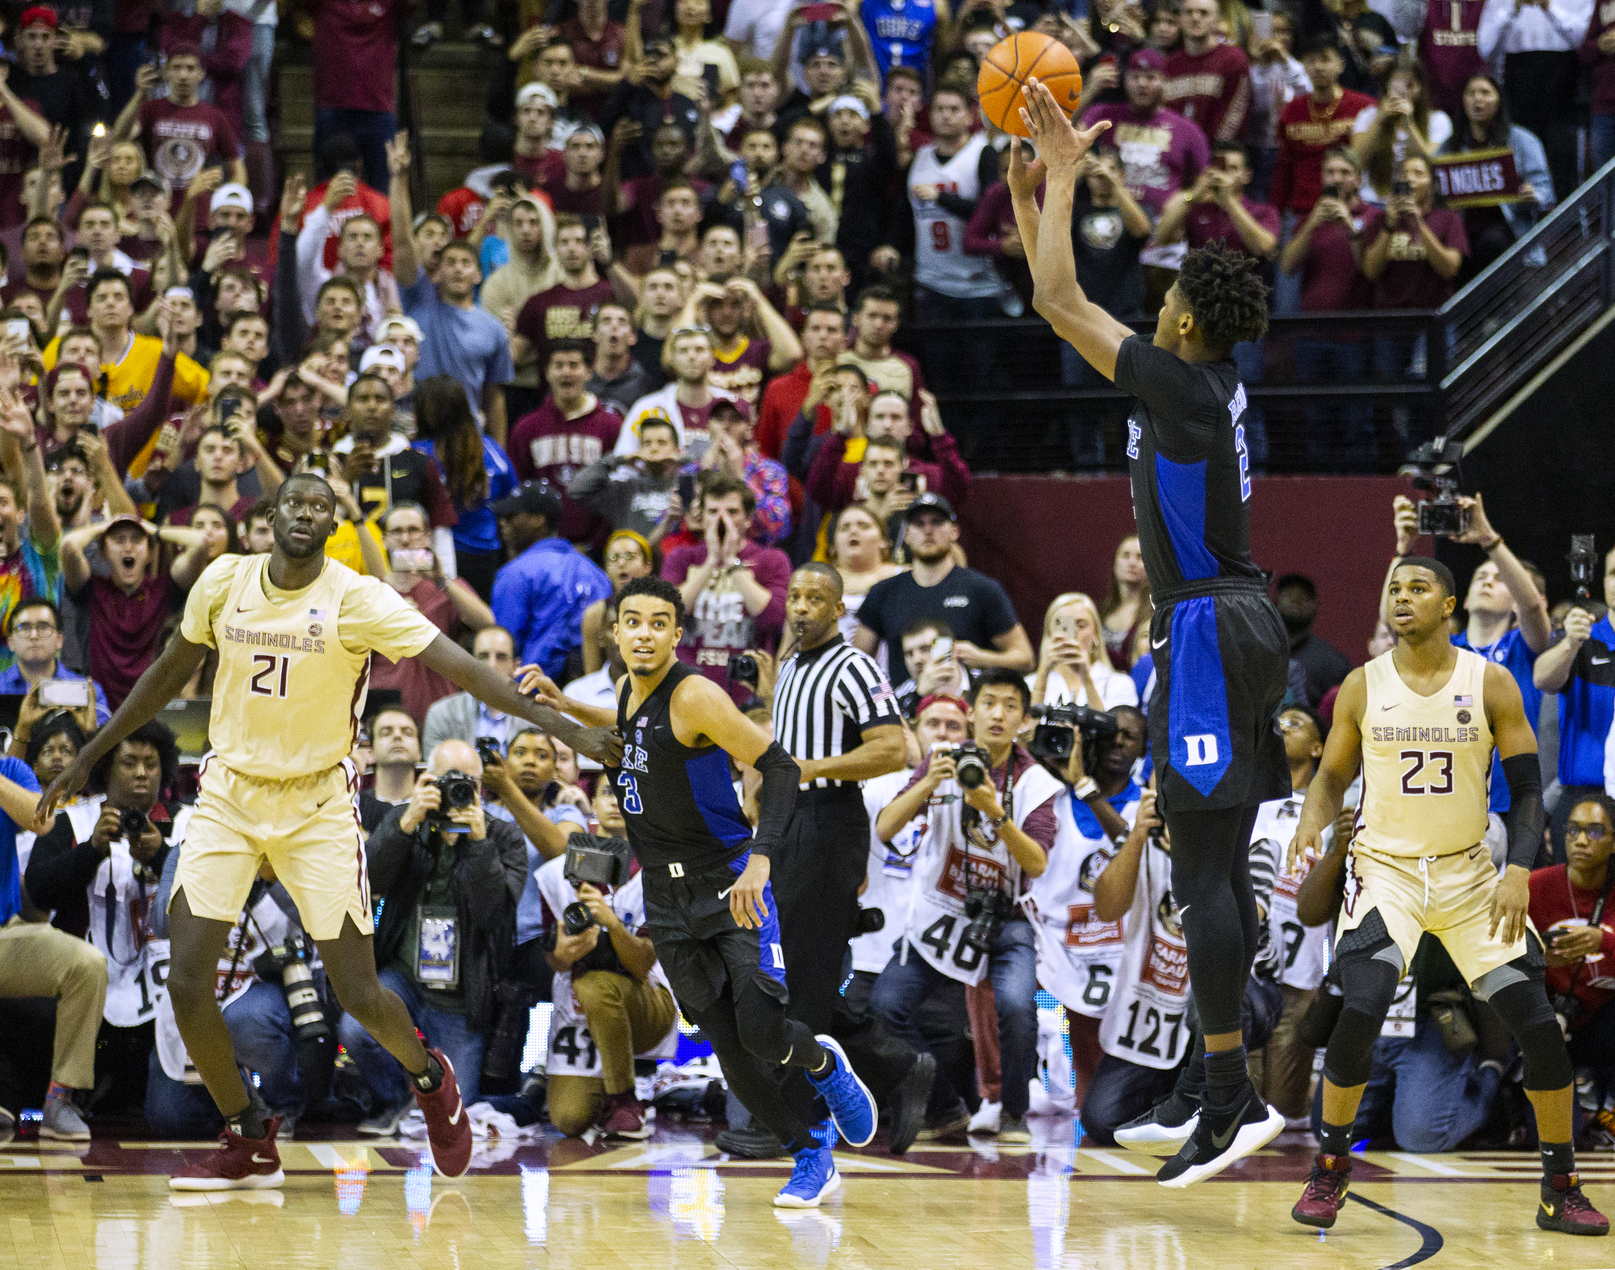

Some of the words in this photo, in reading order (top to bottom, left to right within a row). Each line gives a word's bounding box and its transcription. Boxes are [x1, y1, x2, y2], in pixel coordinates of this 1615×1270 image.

[1449, 161, 1505, 194] NOLES
[931, 221, 949, 251] 9
[1235, 423, 1251, 502] 2
[225, 626, 325, 653] SEMINOLES
[696, 648, 729, 666] FSU
[250, 652, 290, 699] 21
[1371, 726, 1479, 742] SEMINOLES
[617, 770, 644, 814] 3
[1399, 748, 1454, 796] 23
[921, 914, 984, 971] 46
[1082, 964, 1113, 1006] 6
[1117, 1000, 1185, 1060] 127
